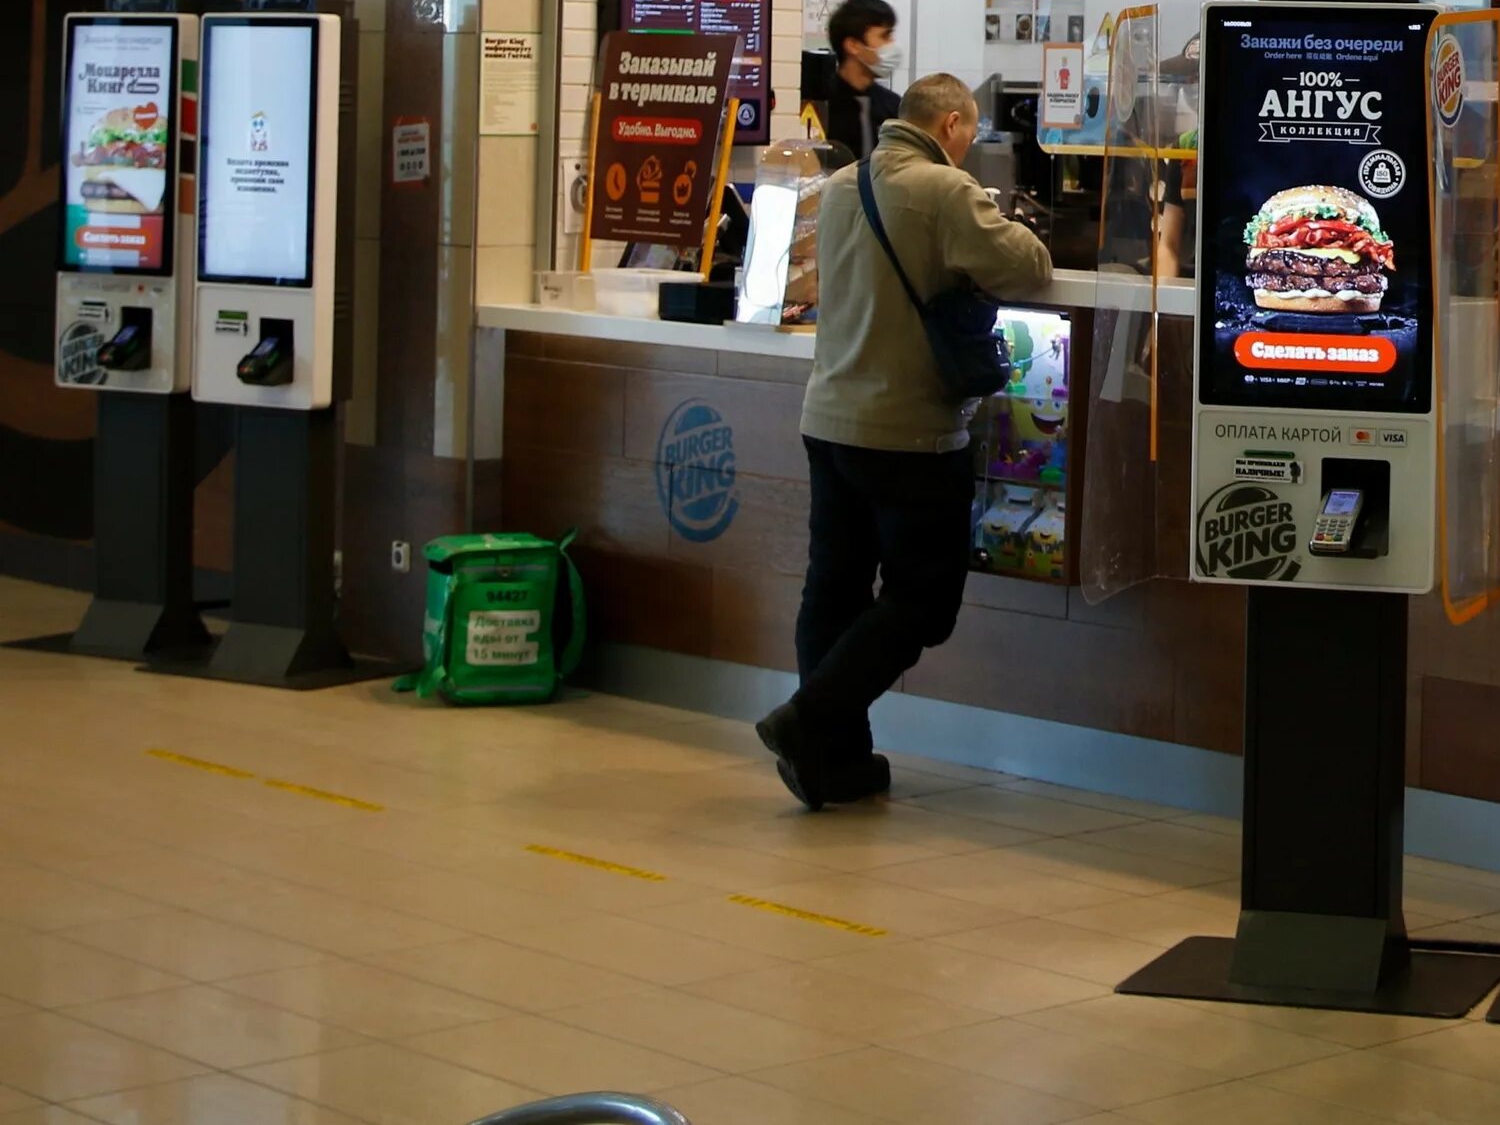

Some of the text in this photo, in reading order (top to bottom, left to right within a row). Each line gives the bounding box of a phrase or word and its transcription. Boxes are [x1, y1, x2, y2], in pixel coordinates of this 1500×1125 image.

[1240, 34, 1404, 54] Закажи без очереди
[79, 63, 160, 81] Моцарелла
[619, 51, 717, 77] Заказывай
[1438, 52, 1460, 87] BURGER
[87, 78, 125, 94] Кинг
[1299, 72, 1343, 87] 100%
[1438, 67, 1462, 105] KING
[609, 82, 717, 107] в терминале
[1258, 89, 1382, 120] АНГУС
[619, 122, 697, 139] Удобно. Выгодно.
[1280, 126, 1361, 137] КОЛЛЕКЦИЯ
[1251, 341, 1379, 362] Сделать заказ
[1215, 424, 1341, 443] ОПЛАТА КАРТОЙ
[1383, 433, 1404, 443] VISA
[663, 426, 733, 466] BURGER
[1204, 502, 1293, 543] BURGER
[1207, 522, 1297, 573] KING
[473, 649, 488, 660] 15
